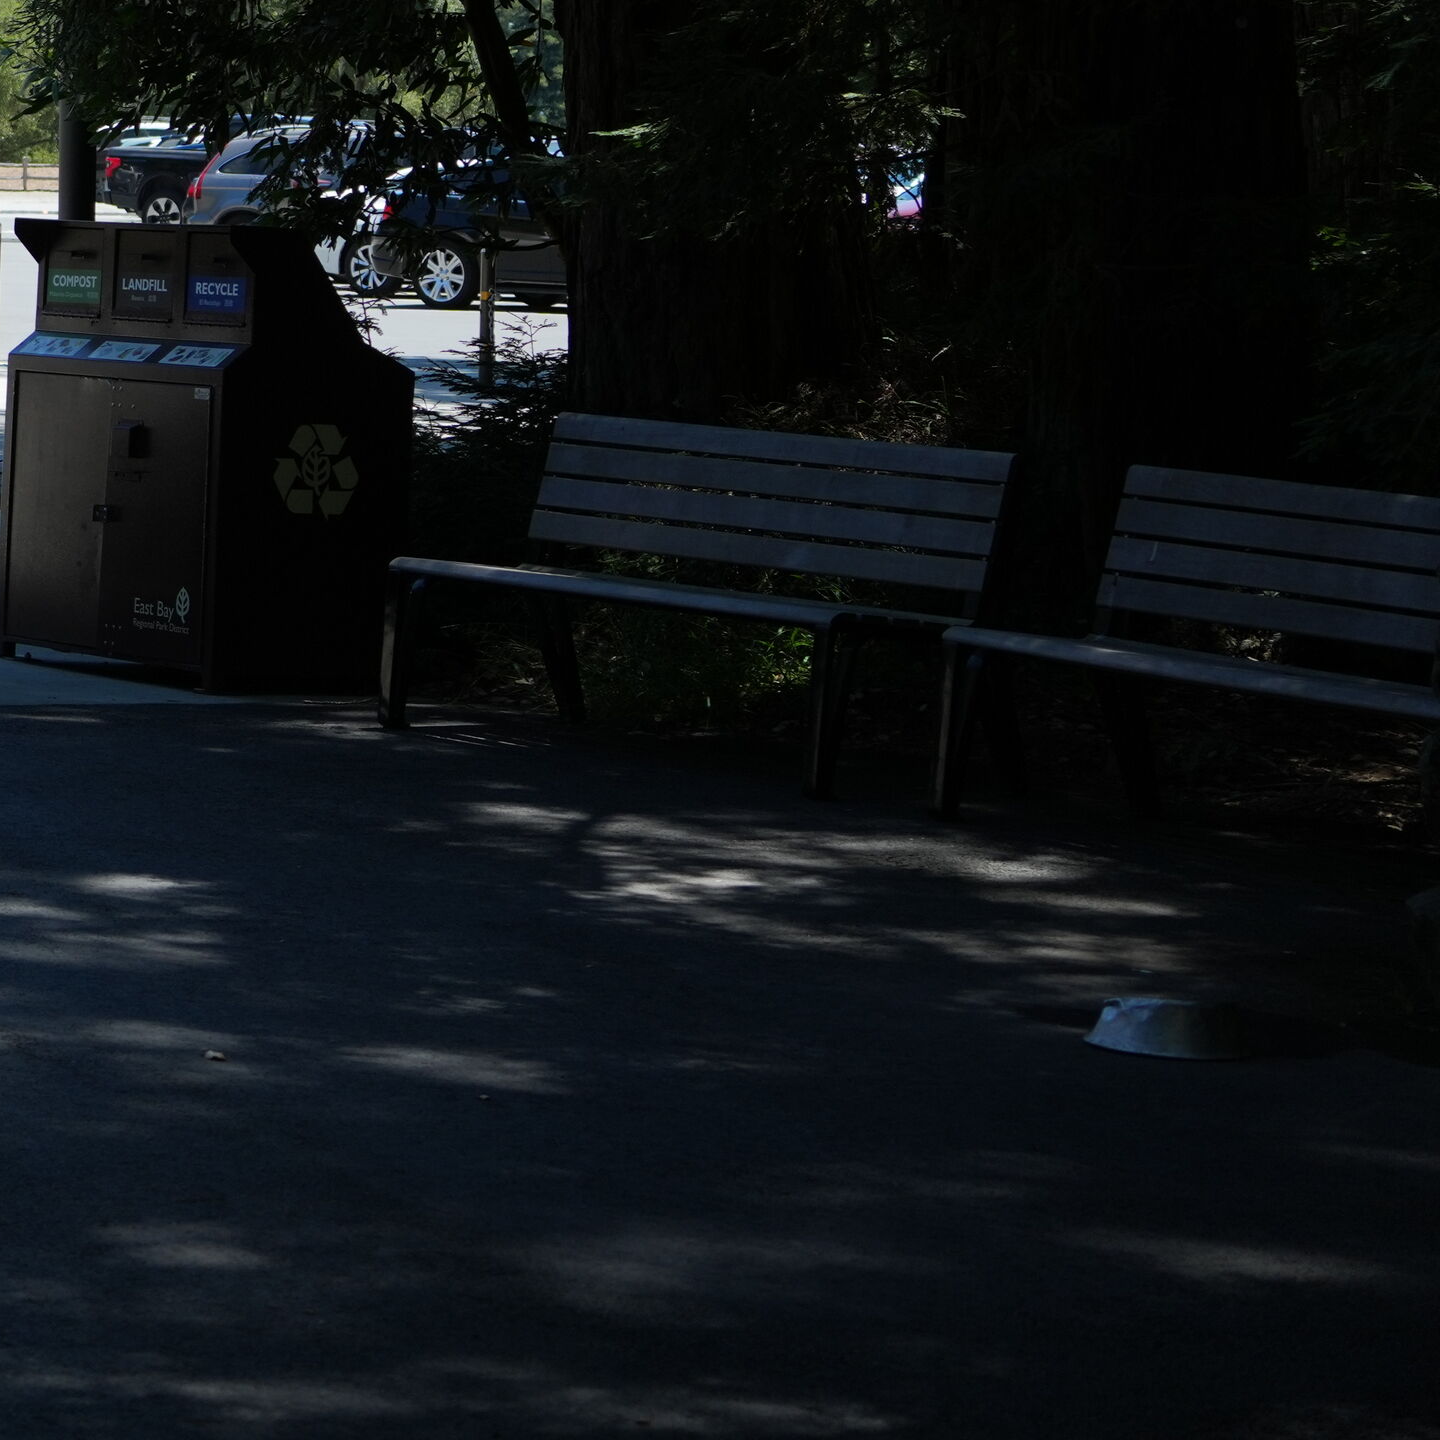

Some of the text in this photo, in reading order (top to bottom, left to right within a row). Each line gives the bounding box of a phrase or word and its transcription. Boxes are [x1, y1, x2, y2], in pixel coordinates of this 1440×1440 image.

[53, 275, 97, 288] COMPOST
[122, 278, 167, 292] LANDFILL
[195, 282, 239, 296] RECYCLE
[134, 597, 175, 623] East Bay
[156, 621, 169, 631] Park
